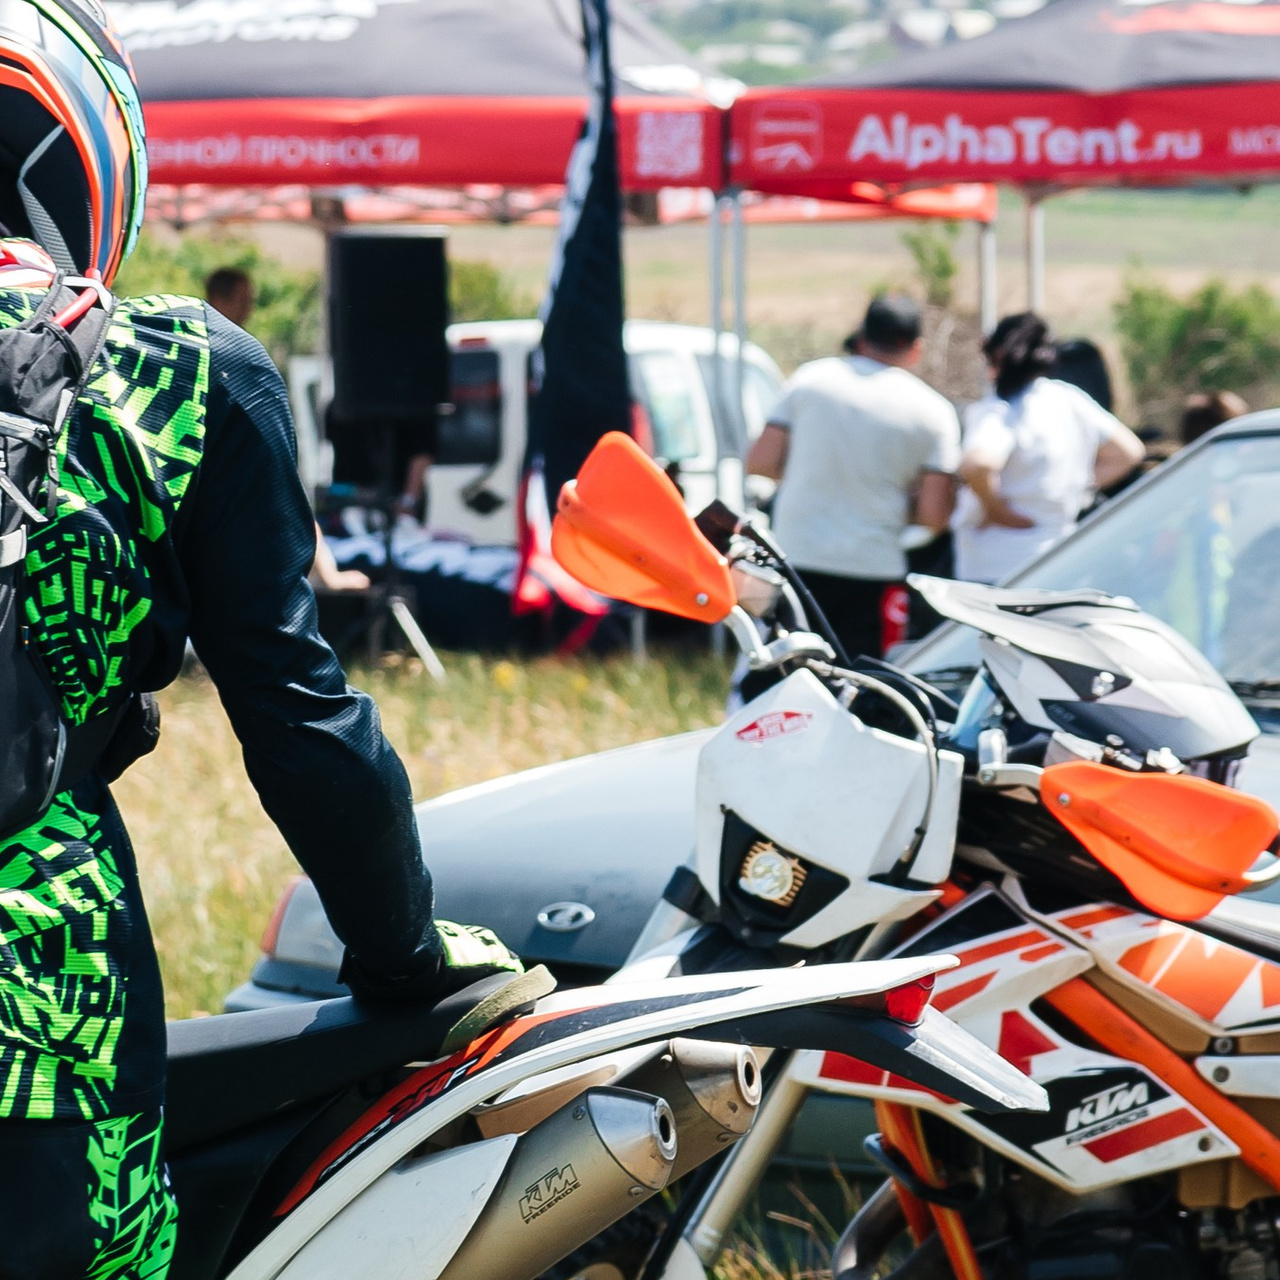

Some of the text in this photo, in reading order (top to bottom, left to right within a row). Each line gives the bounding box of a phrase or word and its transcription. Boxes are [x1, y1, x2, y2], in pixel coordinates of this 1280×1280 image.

[847, 112, 1202, 170] AlphaTent.ru
[1065, 1081, 1149, 1133] KTM
[519, 1163, 578, 1220] KTM
[524, 1181, 581, 1224] FREERIDE
